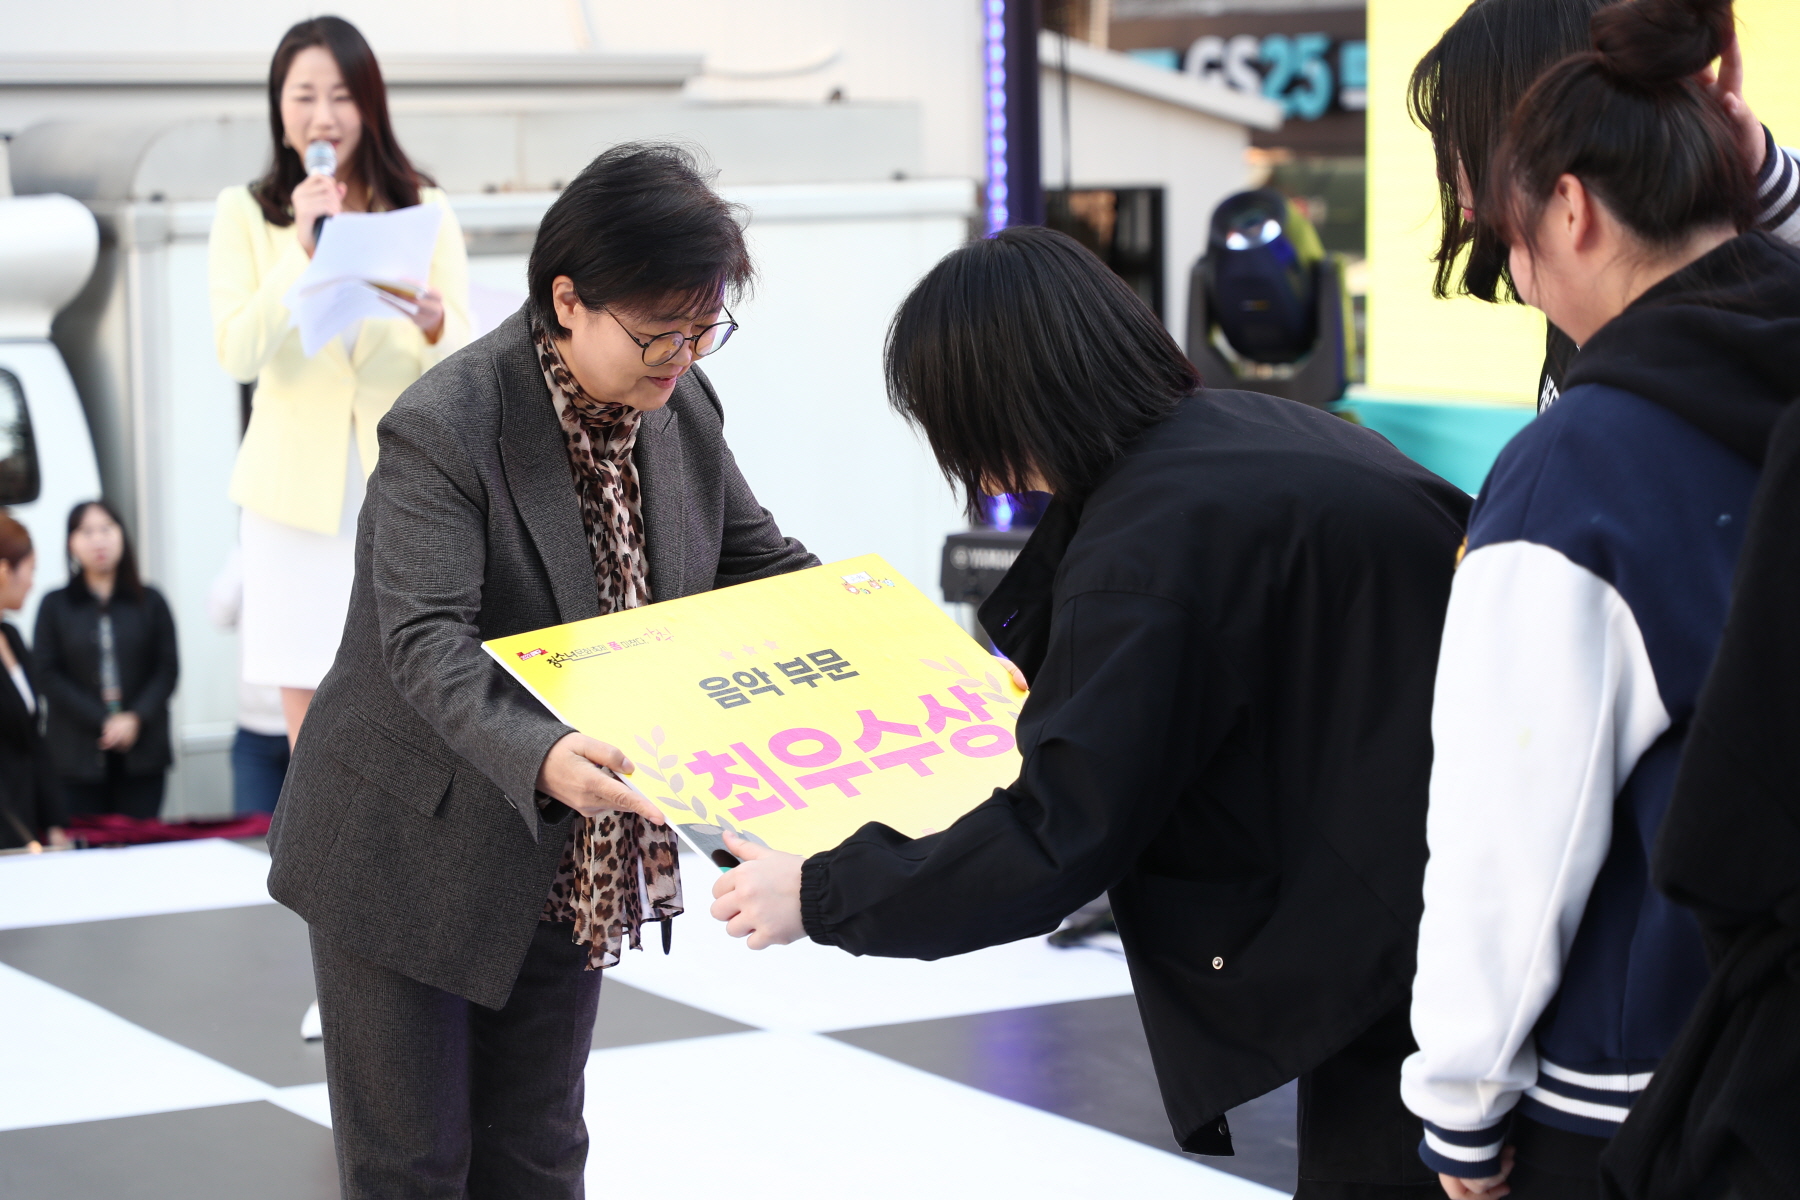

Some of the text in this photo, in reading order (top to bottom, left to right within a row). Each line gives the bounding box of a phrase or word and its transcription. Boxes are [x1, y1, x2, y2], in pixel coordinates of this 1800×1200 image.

[607, 641, 623, 651] 폼
[699, 648, 860, 709] 음악 부문
[684, 685, 1015, 821] 최우수상
